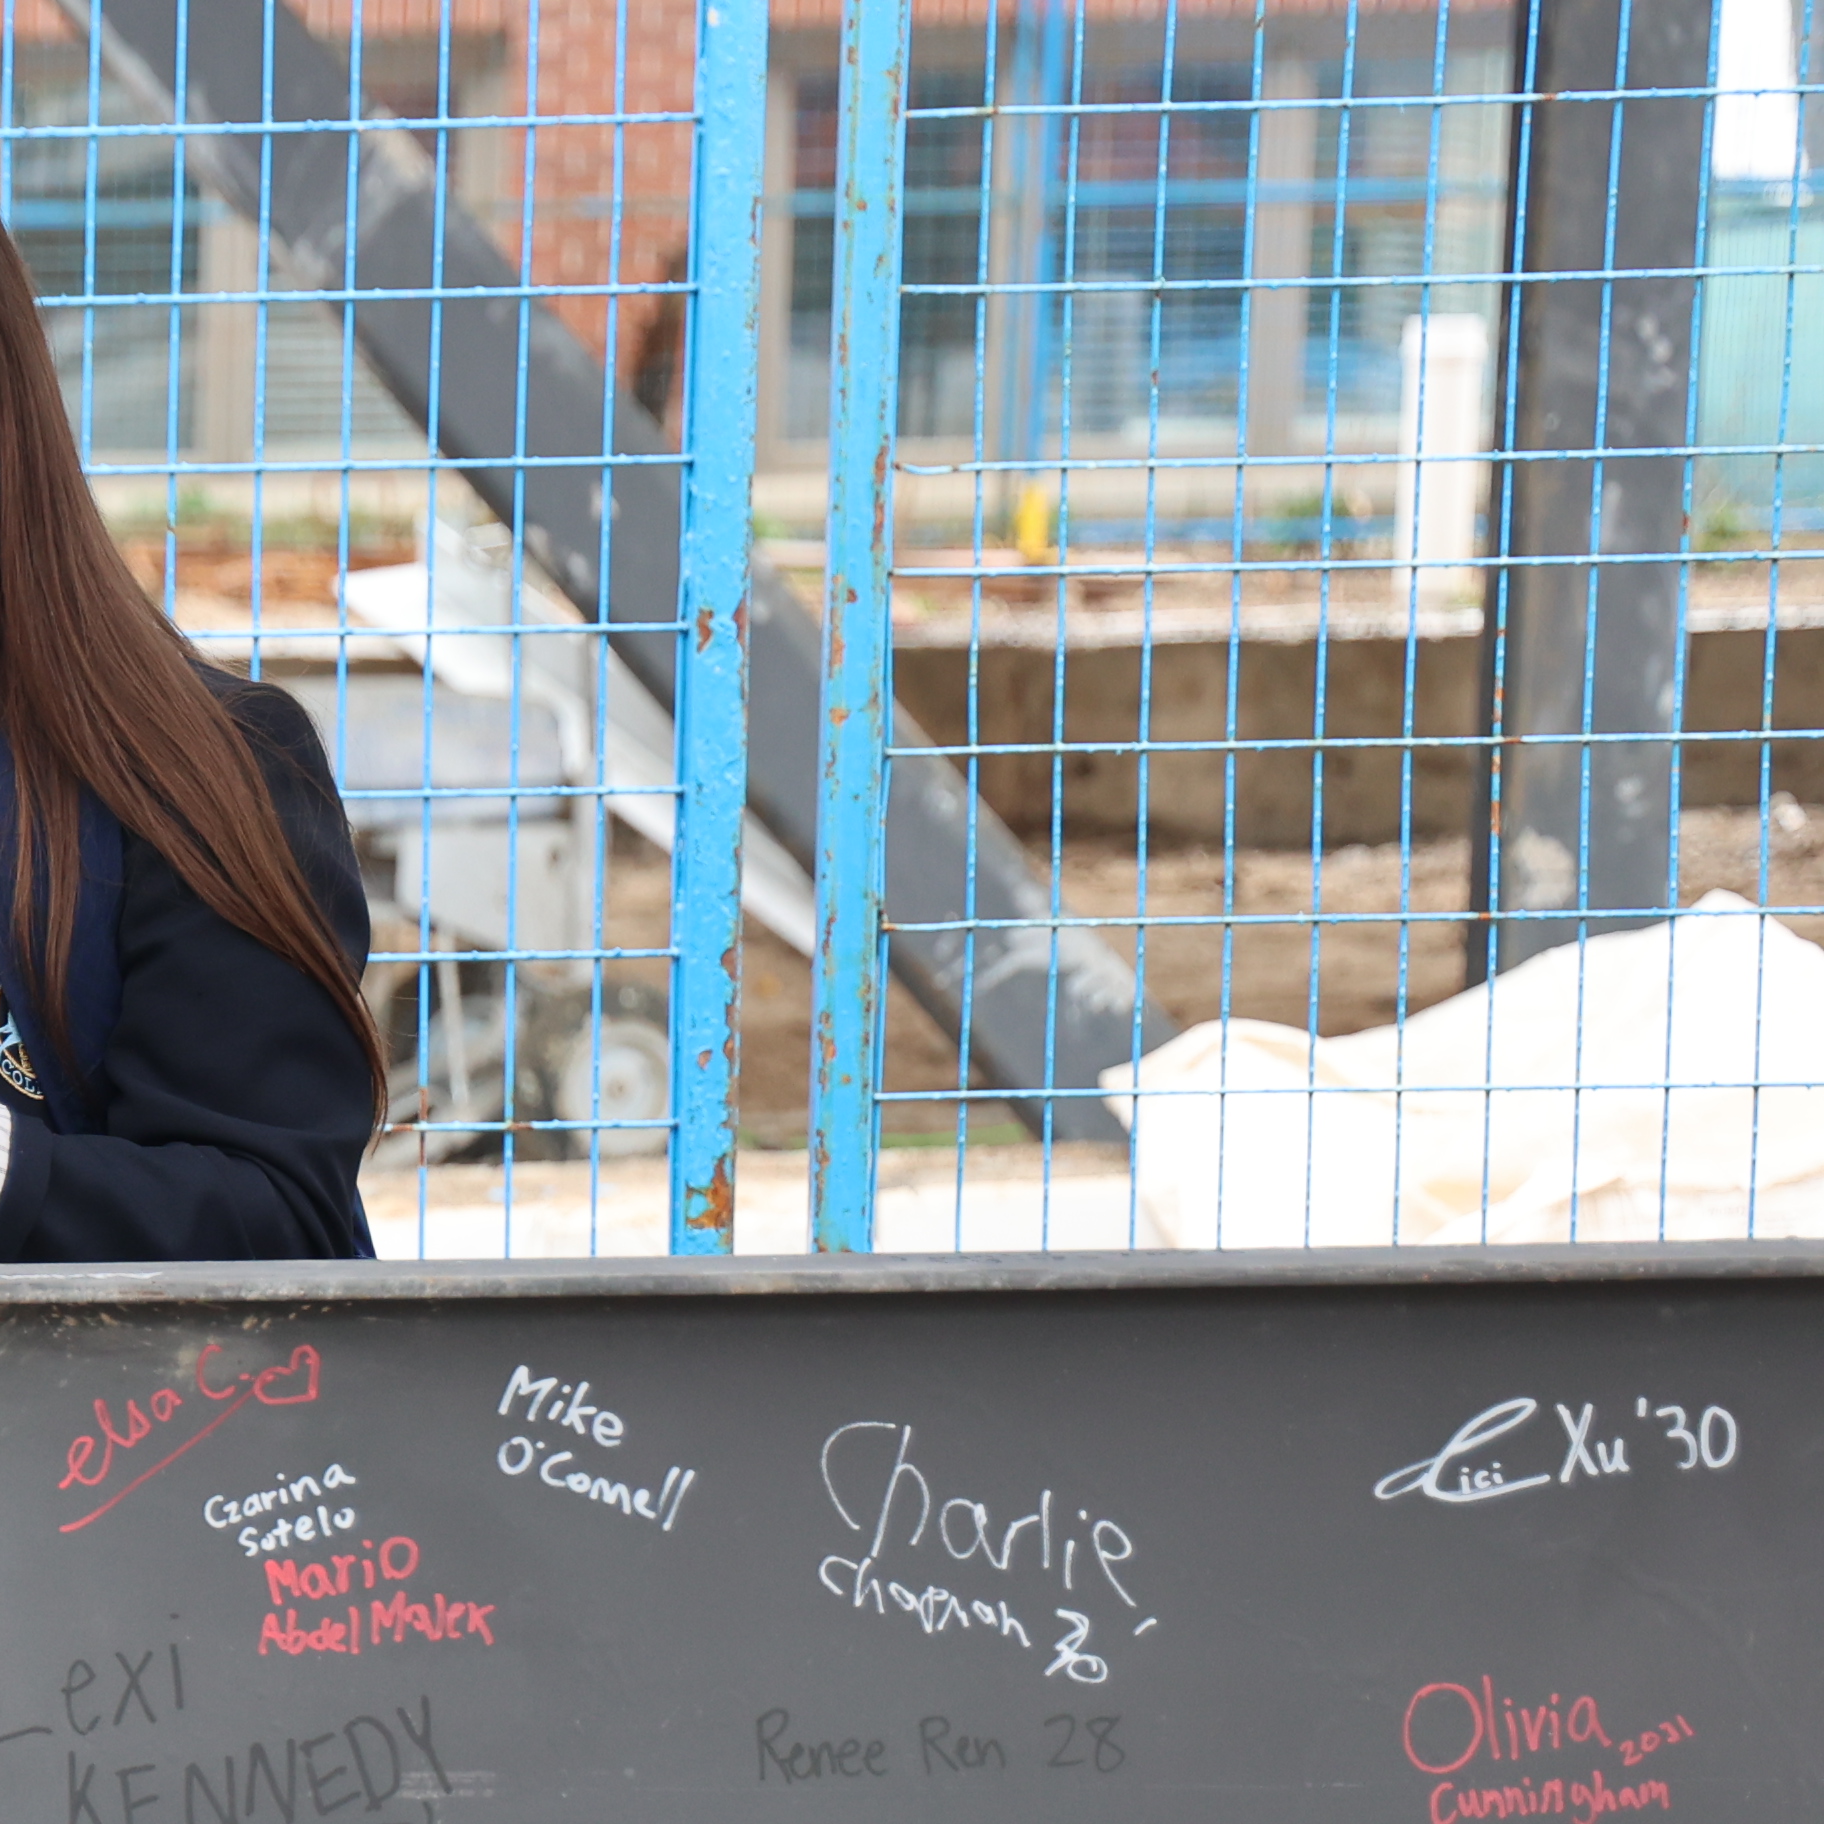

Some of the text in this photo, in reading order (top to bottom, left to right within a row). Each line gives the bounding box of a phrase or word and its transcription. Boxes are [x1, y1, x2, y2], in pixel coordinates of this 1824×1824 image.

[498, 1365, 624, 1450] Mike
[1556, 1403, 1629, 1483] Xu
[1637, 1397, 1737, 1469] '30
[1400, 1672, 1612, 1776] Olivia
